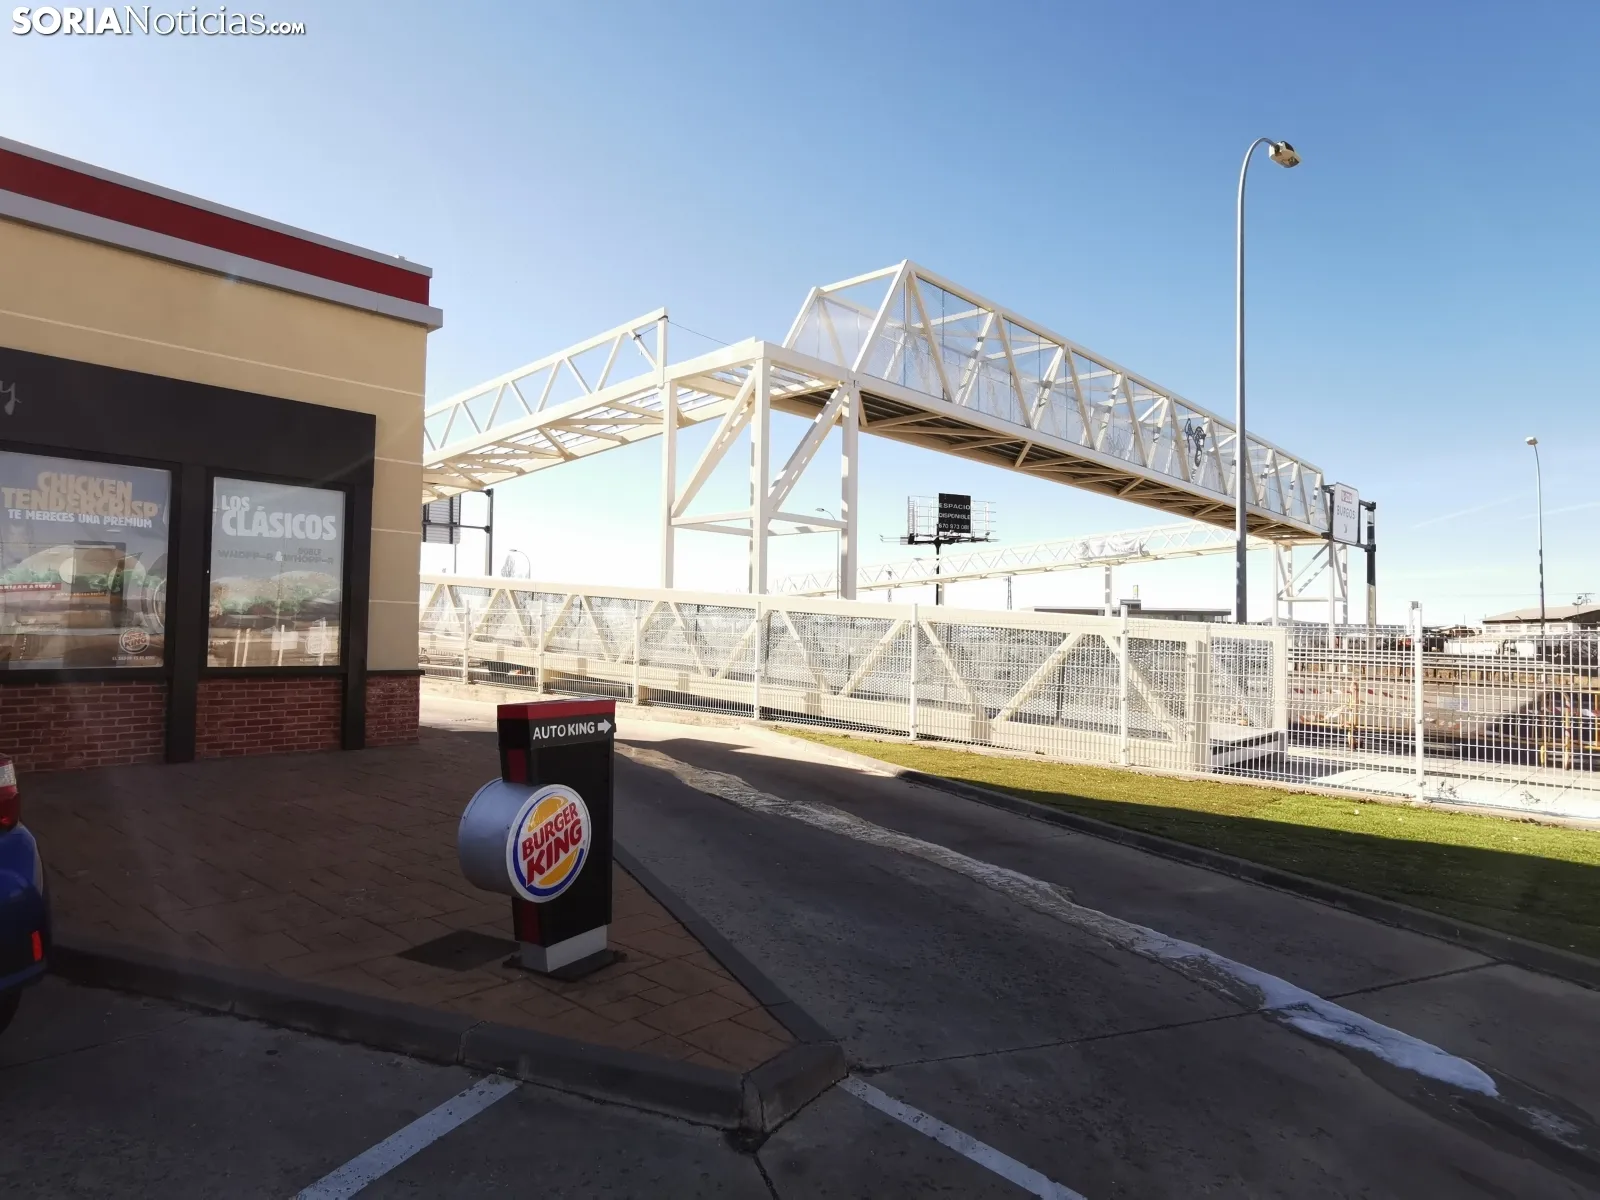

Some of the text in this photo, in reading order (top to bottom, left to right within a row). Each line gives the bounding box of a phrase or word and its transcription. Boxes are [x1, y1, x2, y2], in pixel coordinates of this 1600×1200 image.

[1, 486, 159, 518] TENDERCRISP
[37, 471, 133, 501] CHICKEN
[8, 509, 153, 529] TE MERECES UNA PREMIUM
[221, 495, 250, 512] LOS
[221, 505, 337, 541] CLÁSICOS
[521, 802, 578, 861] BURGER
[525, 818, 583, 887] KING
